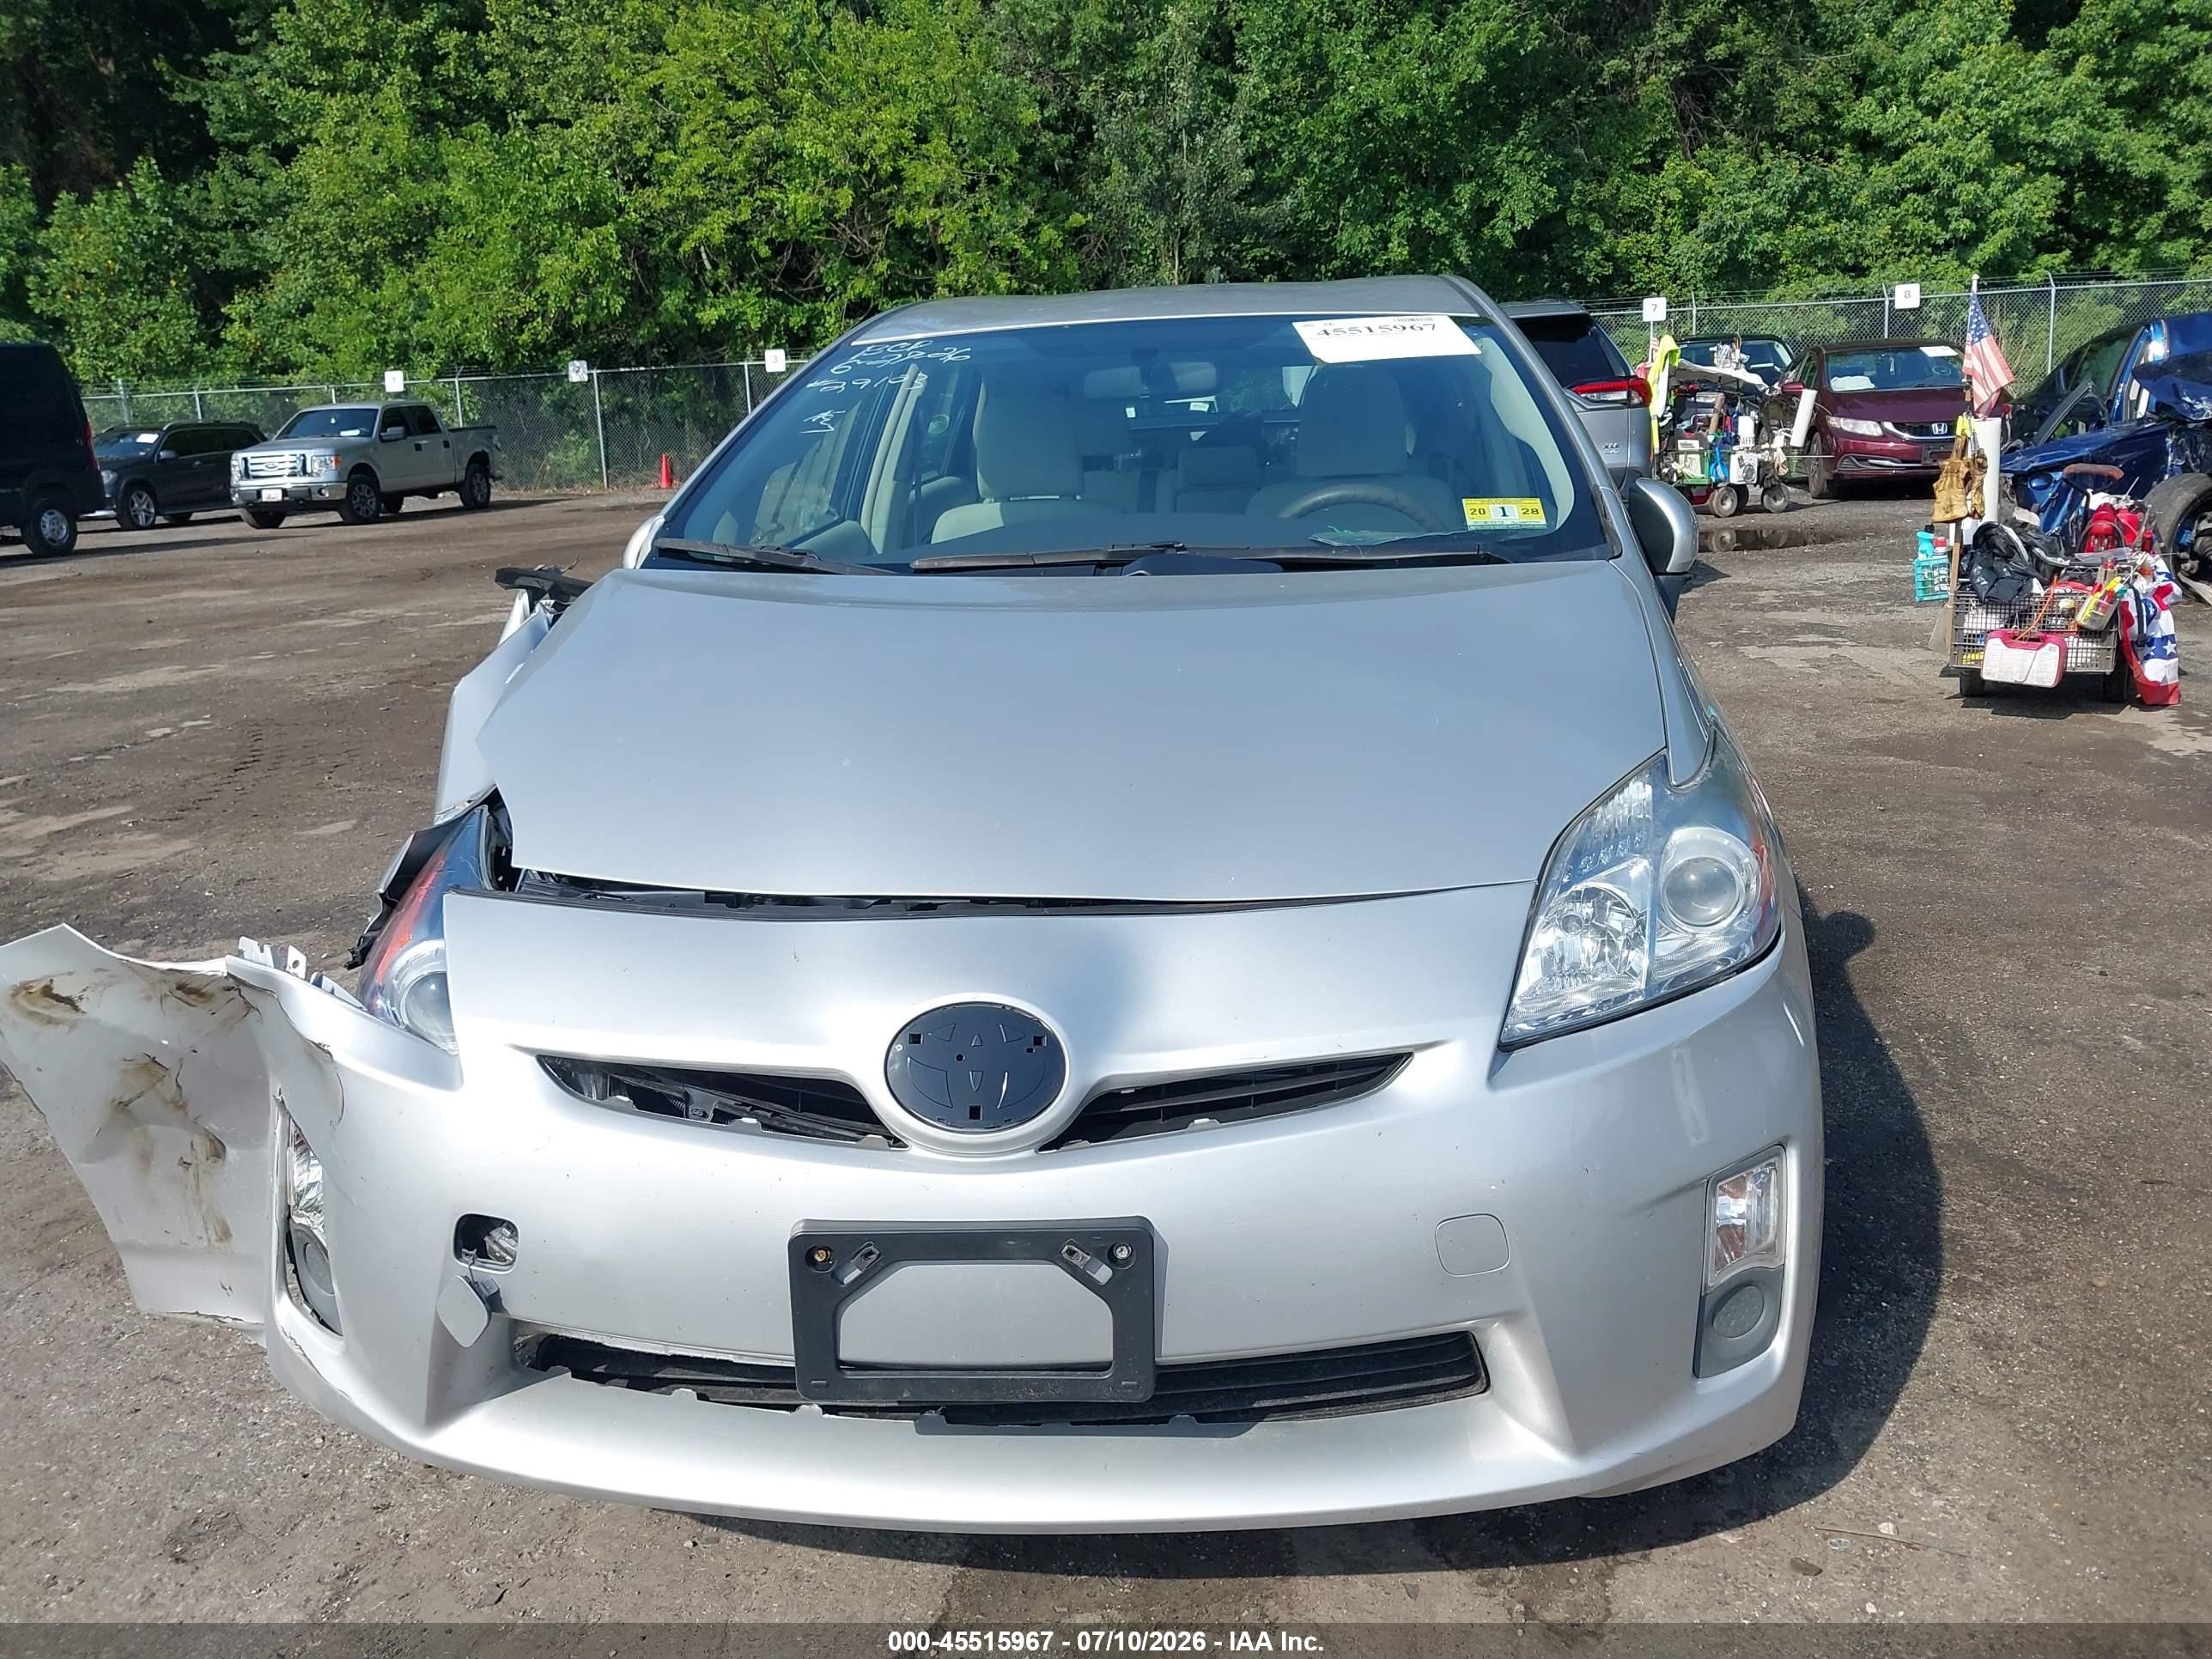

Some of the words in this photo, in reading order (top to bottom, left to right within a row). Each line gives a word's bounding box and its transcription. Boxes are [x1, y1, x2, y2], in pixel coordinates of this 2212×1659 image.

[1904, 290, 1911, 299] 8
[1651, 303, 1657, 312] 7
[1316, 323, 1437, 337] 45515967
[1498, 507, 1509, 517] 1
